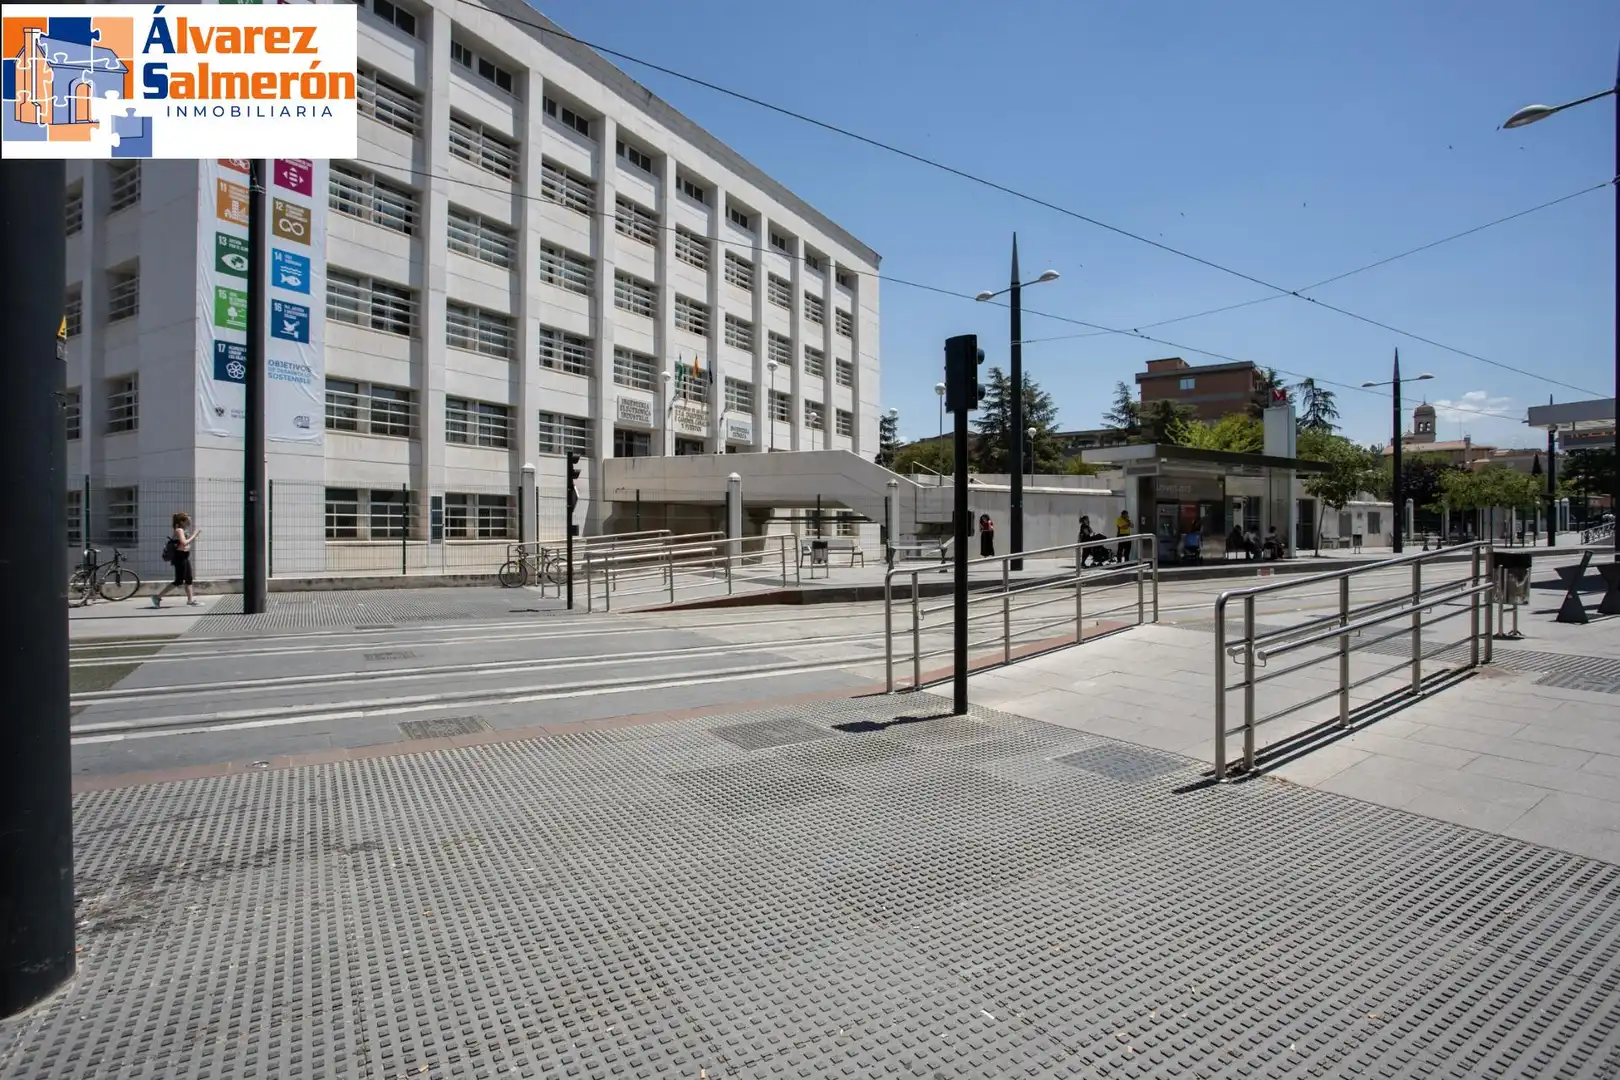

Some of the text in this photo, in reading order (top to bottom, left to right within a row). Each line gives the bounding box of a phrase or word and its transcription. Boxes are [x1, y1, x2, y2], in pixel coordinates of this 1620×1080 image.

[220, 182, 227, 192] 11
[276, 201, 283, 211] 12
[219, 236, 227, 246] 13
[275, 251, 282, 261] 14
[218, 289, 227, 299] 15
[274, 302, 282, 312] 16
[217, 343, 226, 352] 17
[268, 359, 311, 373] OBJETIVOS
[268, 371, 311, 384] SOSTENIBLE
